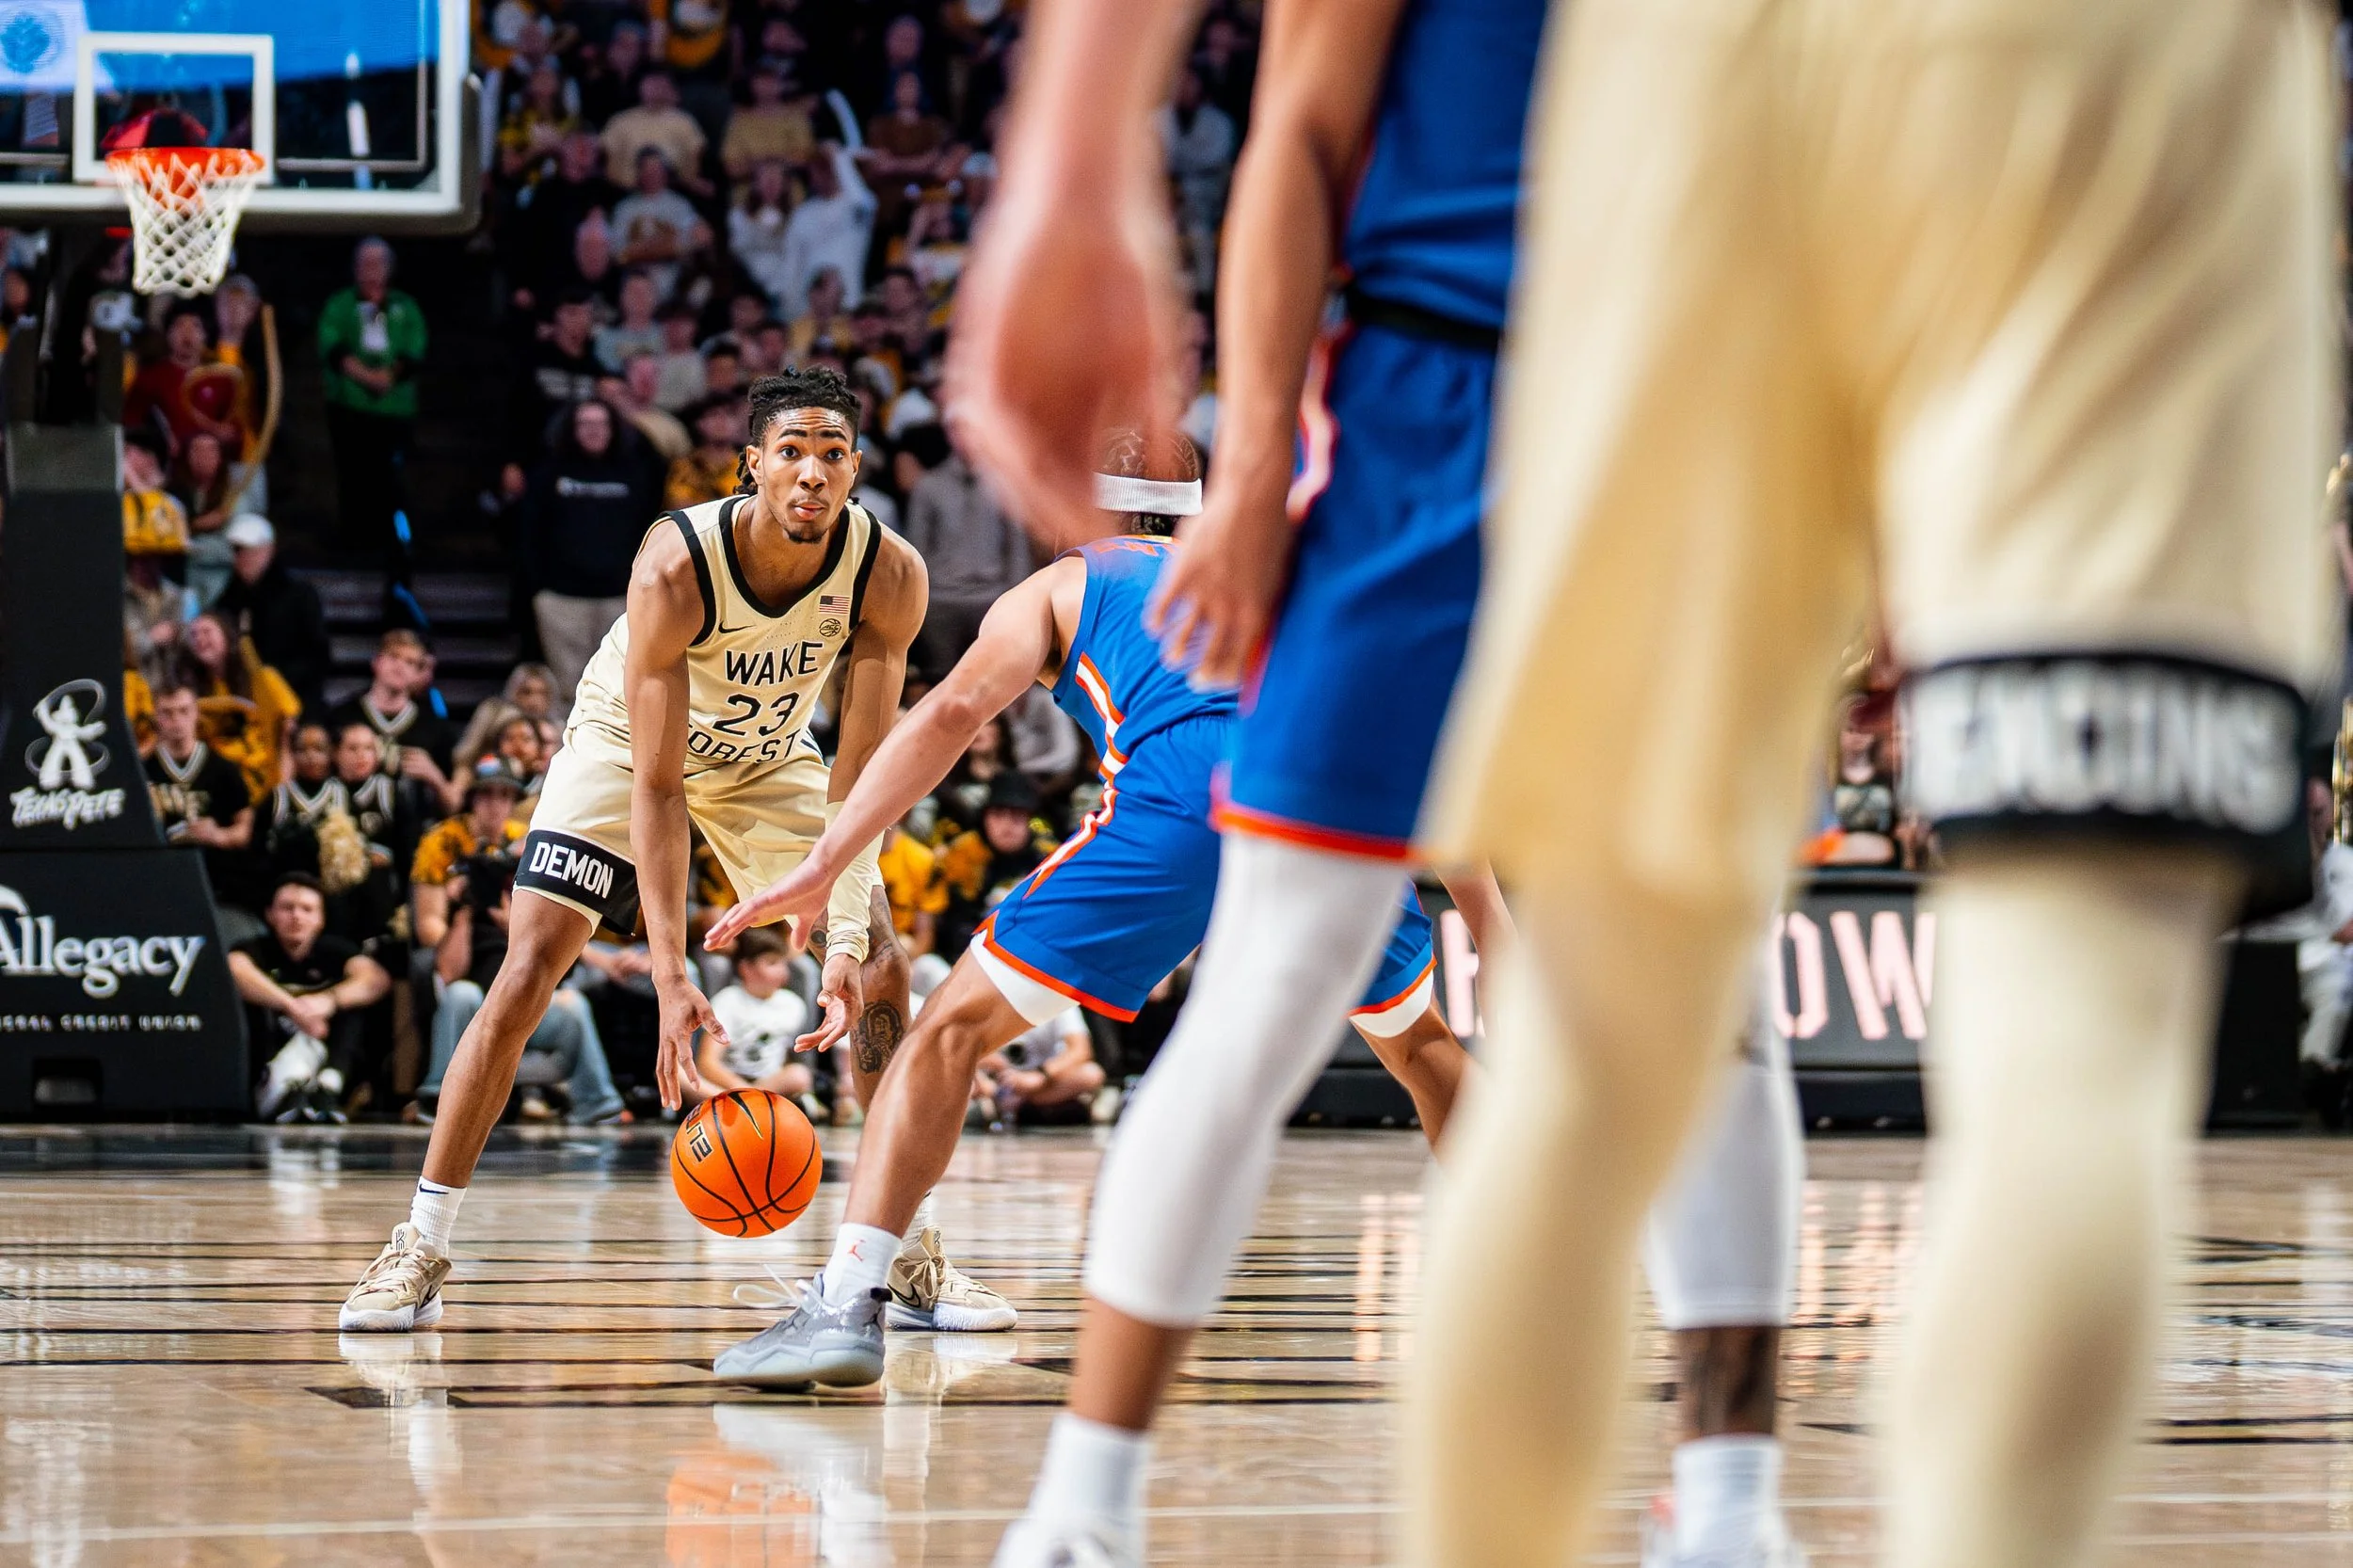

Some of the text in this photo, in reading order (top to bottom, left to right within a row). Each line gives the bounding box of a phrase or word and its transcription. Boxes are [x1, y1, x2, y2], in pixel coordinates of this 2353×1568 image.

[725, 640, 824, 687] WAKE
[712, 691, 800, 737] 23
[688, 724, 802, 762] OREST
[1901, 664, 2298, 834] EACONS
[528, 840, 615, 900] DEMON
[0, 913, 207, 999] Allegacy
